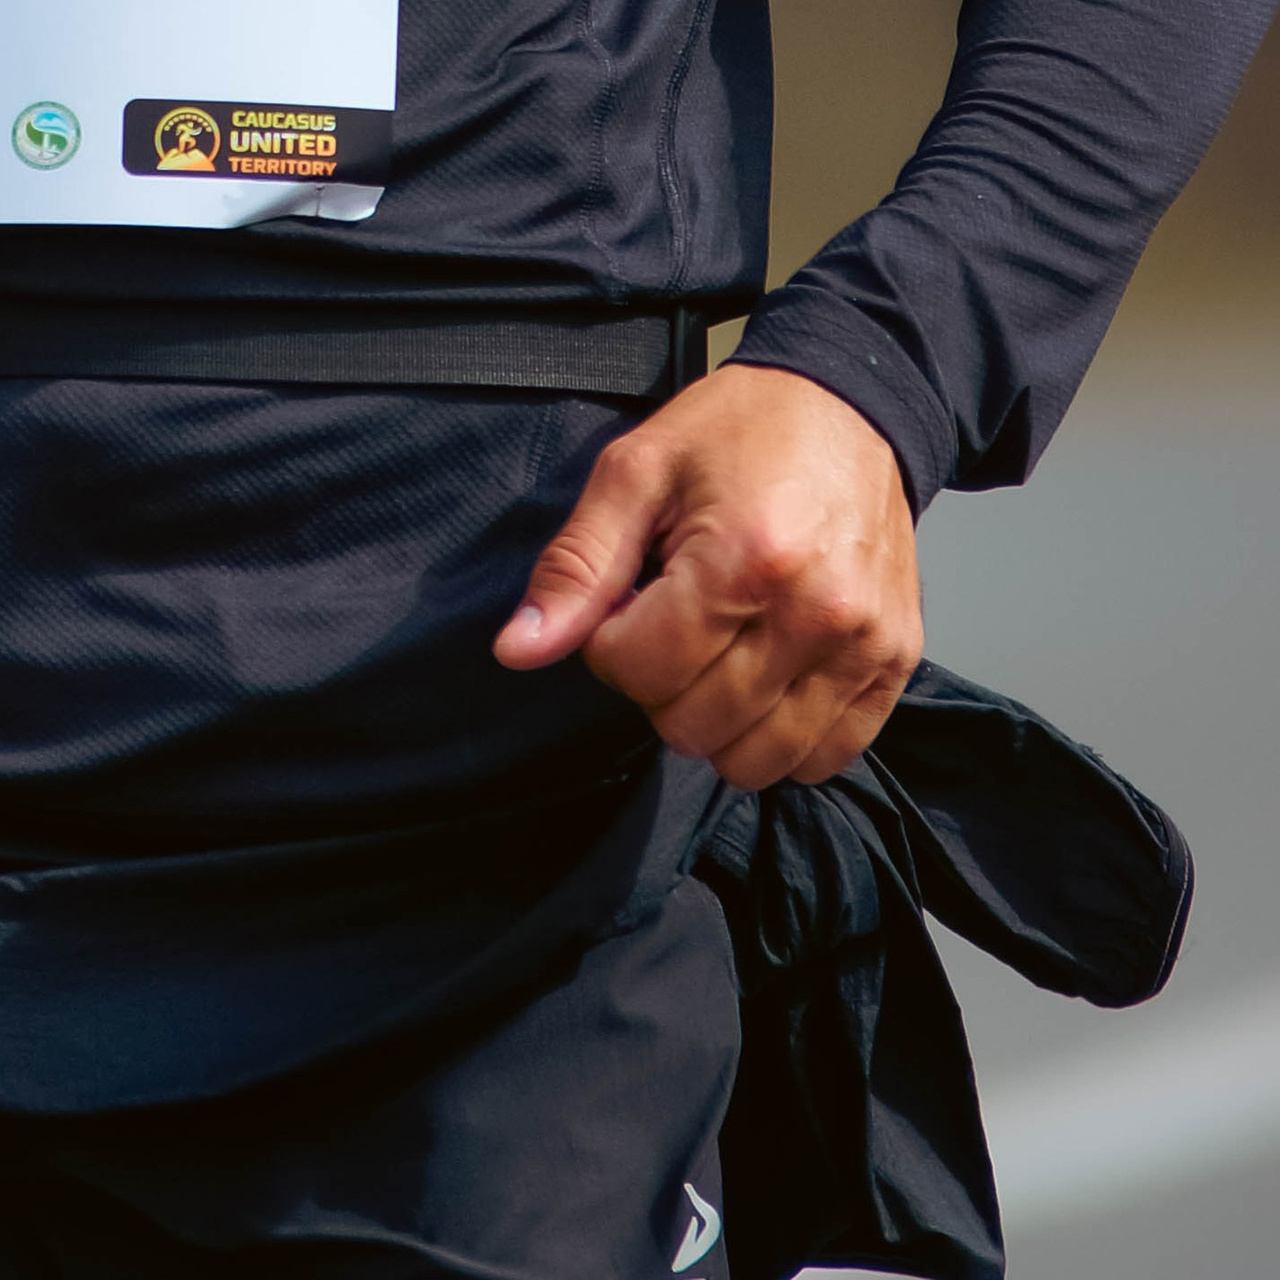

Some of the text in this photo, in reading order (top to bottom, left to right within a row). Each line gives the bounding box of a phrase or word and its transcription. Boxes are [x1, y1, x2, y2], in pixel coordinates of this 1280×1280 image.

[232, 110, 337, 132] CAUCASUS
[229, 130, 337, 157] UNITED
[228, 156, 338, 177] TERRITORY
